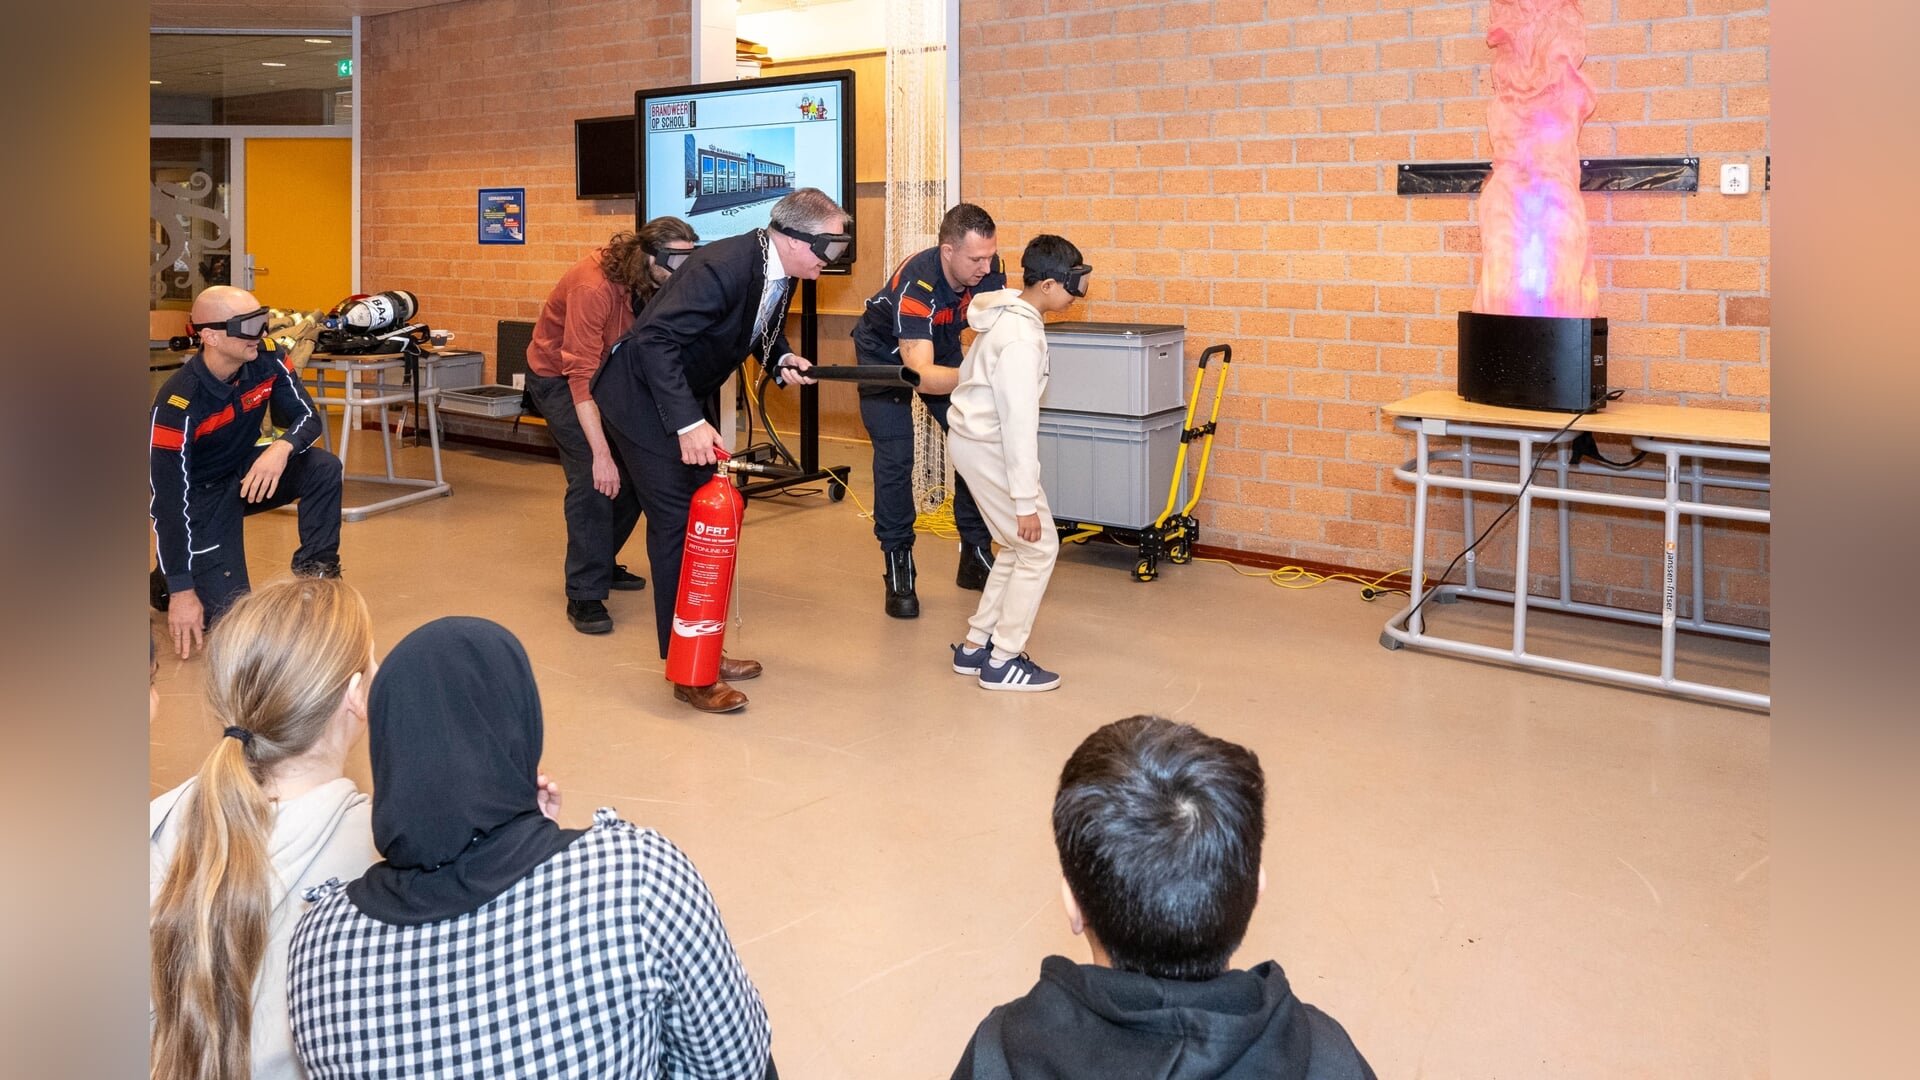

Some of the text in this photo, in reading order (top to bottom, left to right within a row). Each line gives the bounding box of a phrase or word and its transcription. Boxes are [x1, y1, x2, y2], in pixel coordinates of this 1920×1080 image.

[652, 103, 688, 117] BRANDWEER
[651, 116, 685, 129] OP SCHOOL
[705, 525, 730, 535] FRT
